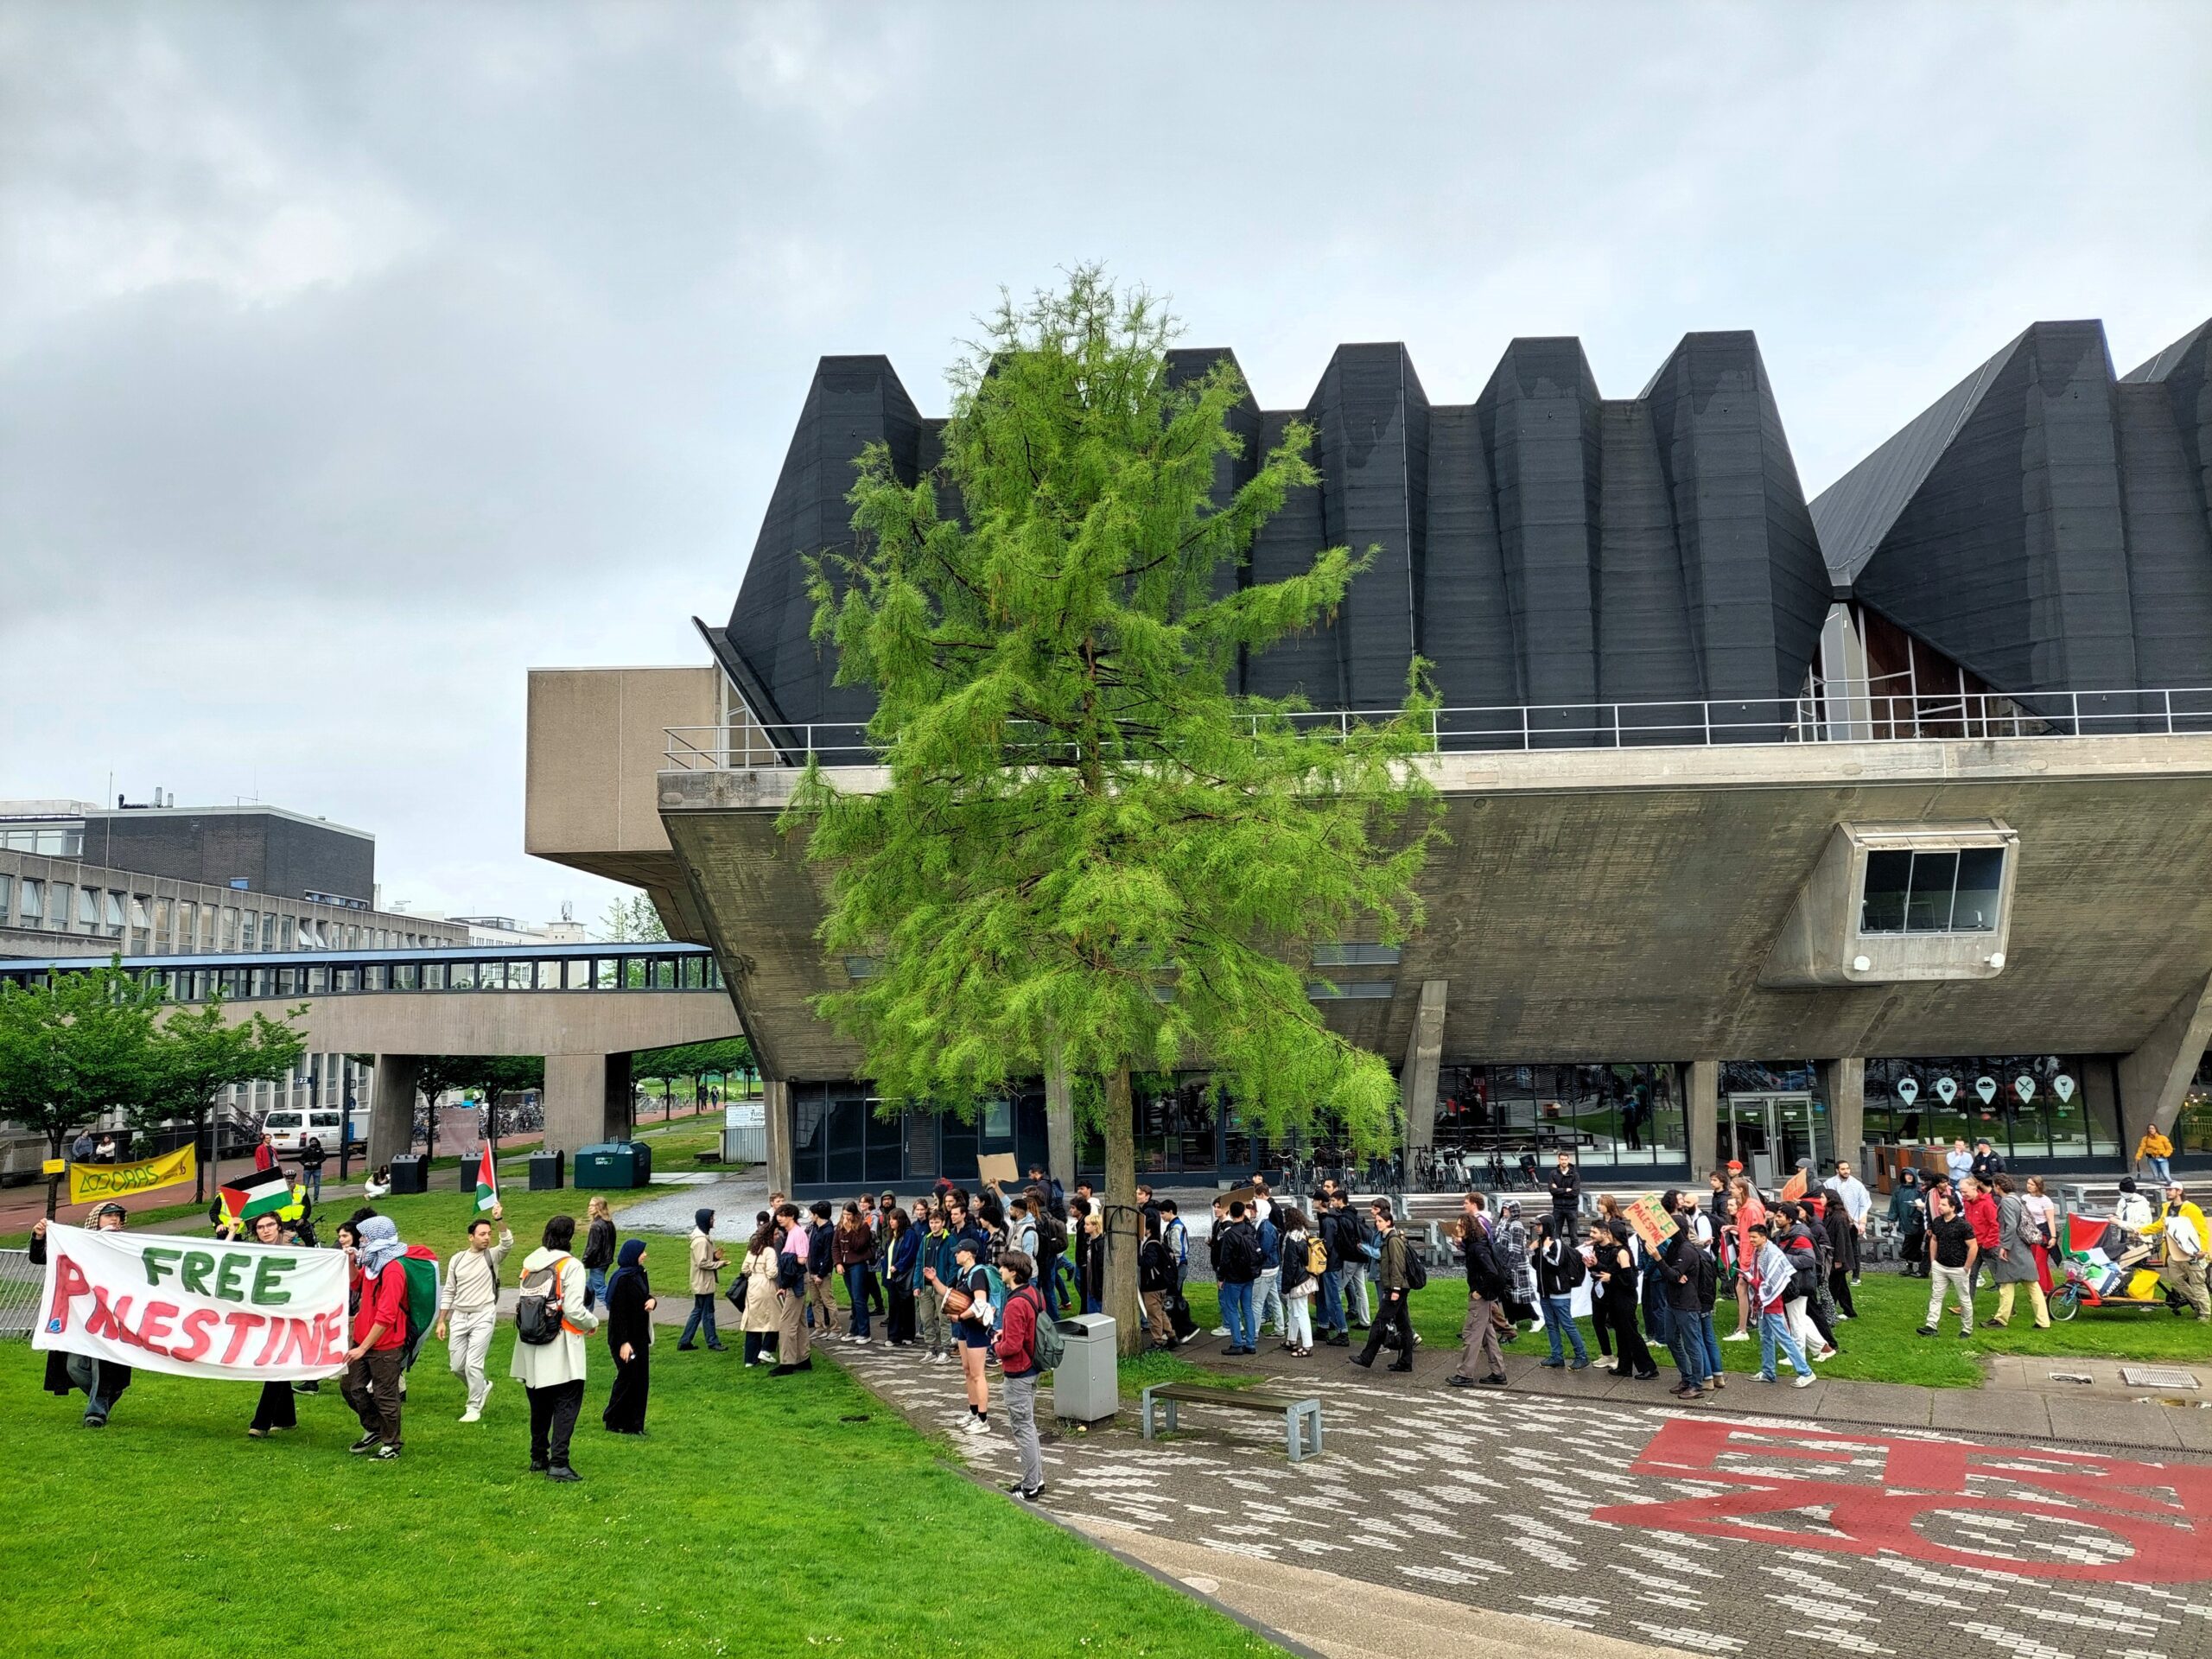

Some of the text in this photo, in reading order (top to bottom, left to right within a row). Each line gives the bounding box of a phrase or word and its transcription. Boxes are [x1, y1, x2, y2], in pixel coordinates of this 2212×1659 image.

[1628, 1203, 1665, 1244] PALESTINE
[1644, 1195, 1676, 1234] FREE
[142, 1247, 297, 1305] FREE
[45, 1253, 345, 1366] PALESTINE
